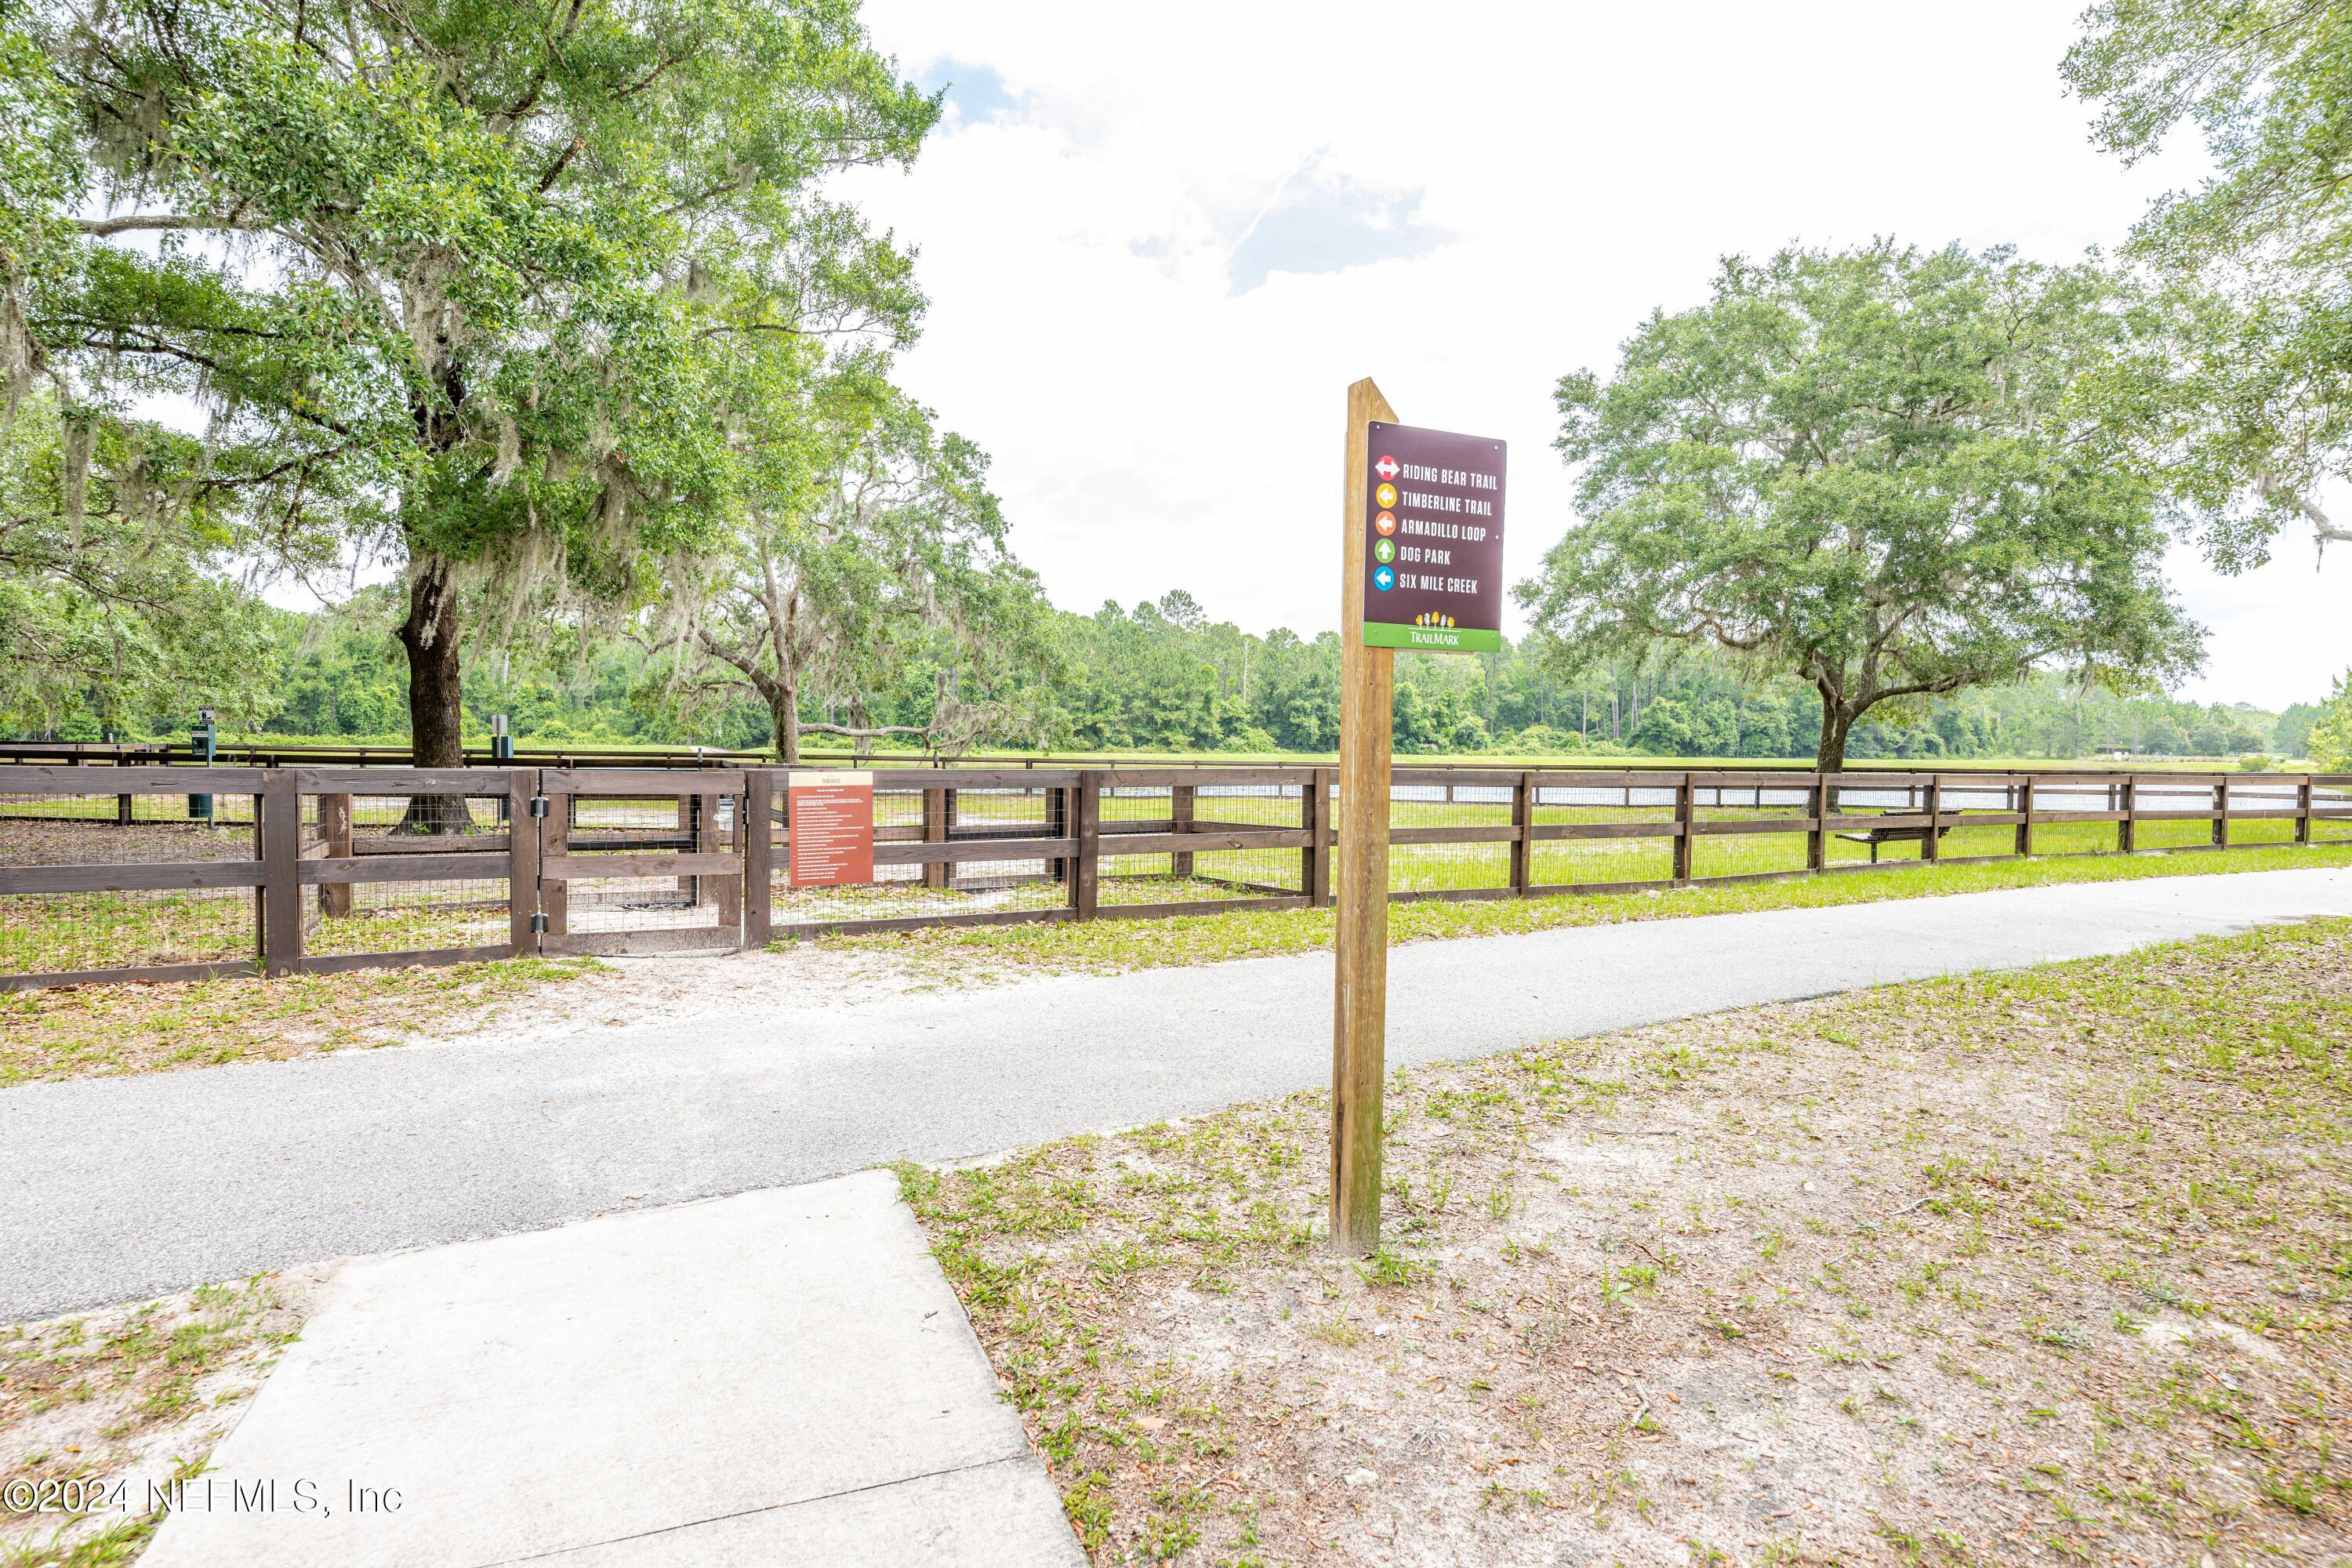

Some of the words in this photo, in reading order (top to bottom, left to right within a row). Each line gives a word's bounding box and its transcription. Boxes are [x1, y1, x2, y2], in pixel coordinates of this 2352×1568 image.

[1403, 464, 1437, 482] RIDING
[1441, 469, 1467, 486] BEAR
[1470, 473, 1497, 490] TRAIL
[1403, 492, 1461, 513] TIMBERLINE
[1465, 499, 1492, 516] TRAIL
[1401, 519, 1458, 539] ARMADILLO
[1461, 524, 1486, 542] LOOP
[1400, 546, 1421, 562] DOG
[1425, 549, 1450, 564] PARK
[1399, 574, 1417, 589] SIX
[1421, 575, 1444, 591] MILE
[1447, 578, 1478, 594] CREEK
